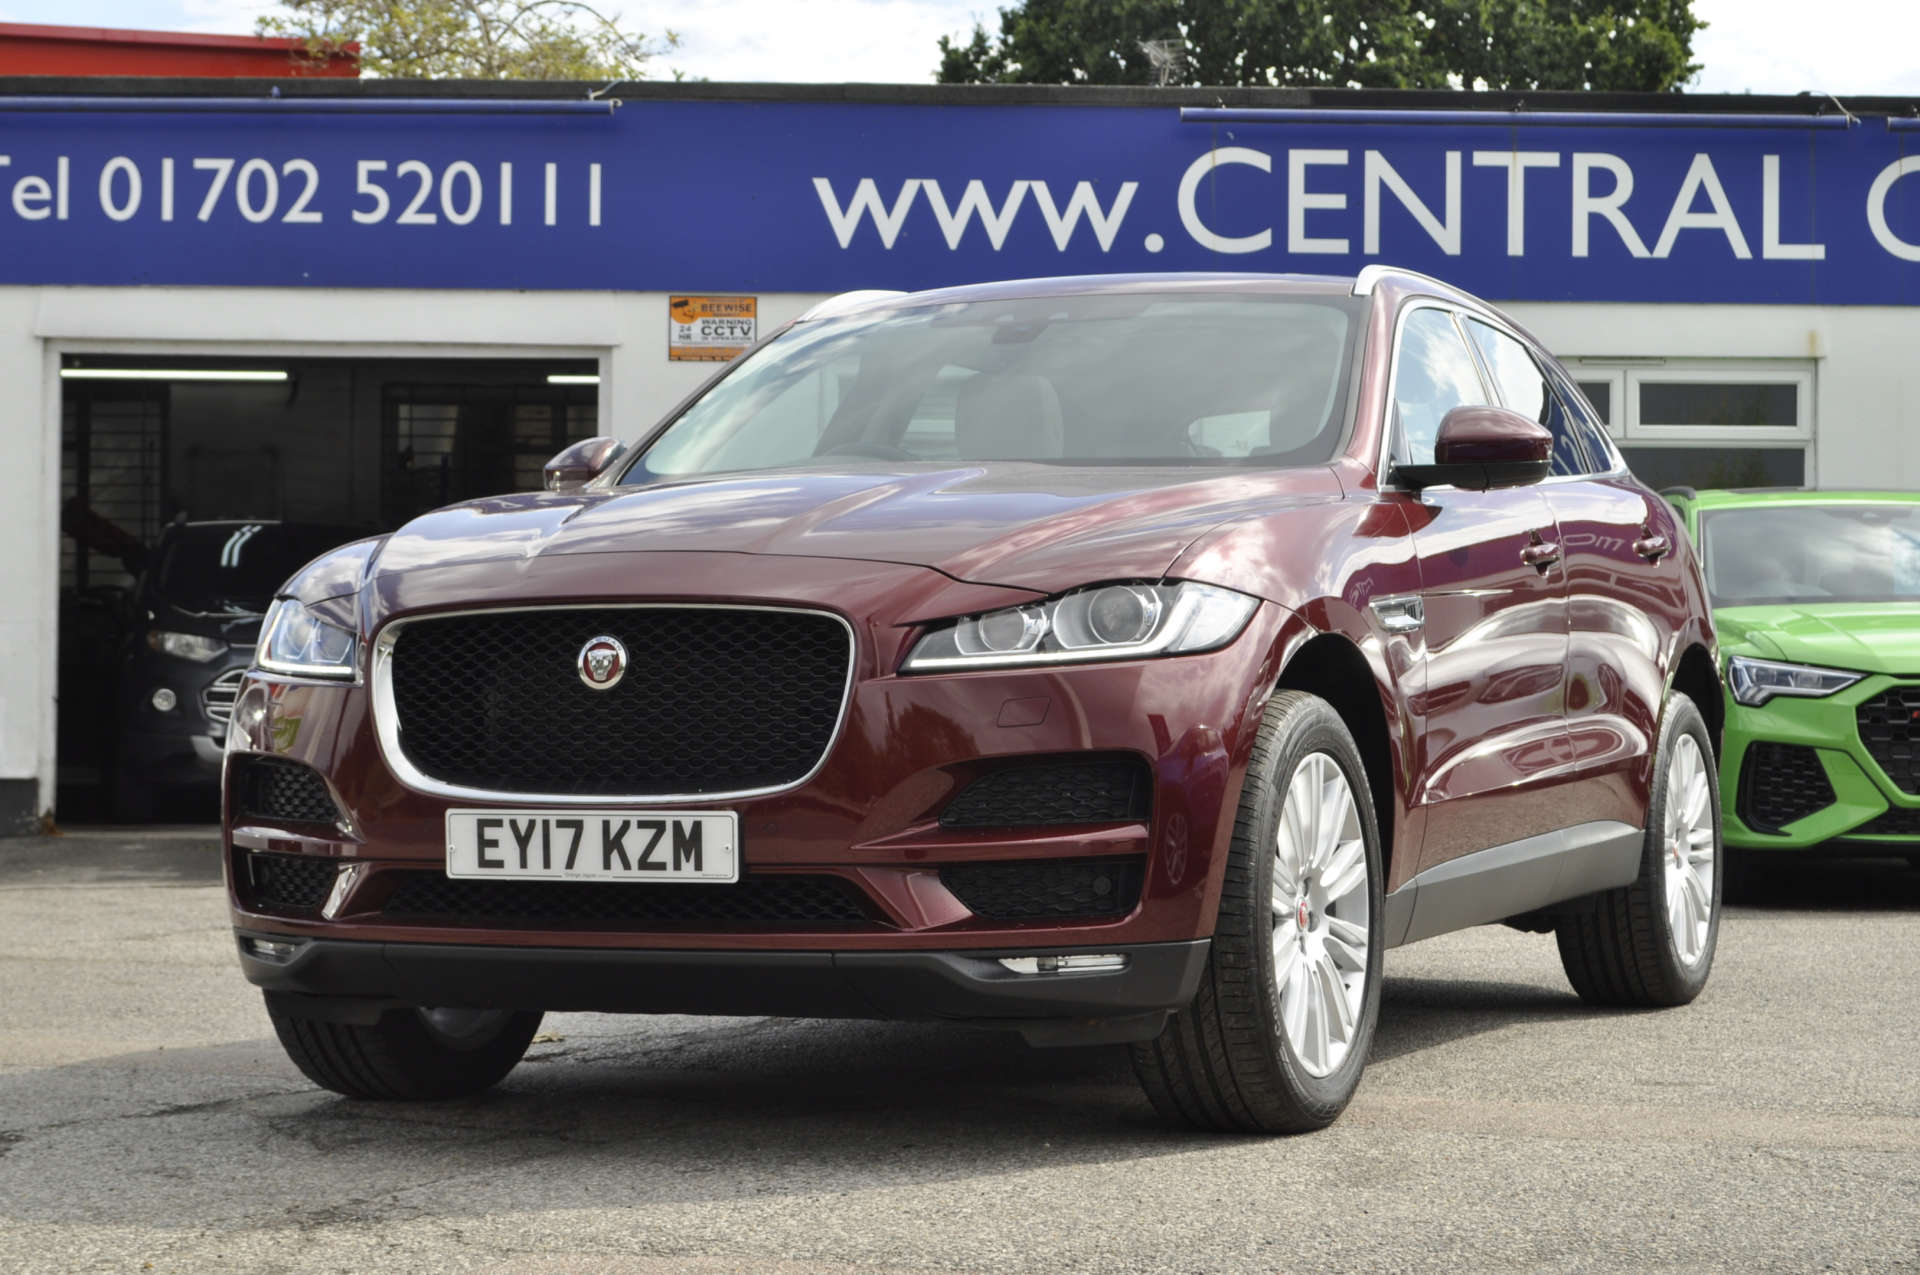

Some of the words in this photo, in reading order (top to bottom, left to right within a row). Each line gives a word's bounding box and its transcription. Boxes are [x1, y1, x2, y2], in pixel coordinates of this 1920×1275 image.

[99, 156, 323, 223] 01702
[352, 160, 602, 227] 520111
[812, 146, 1826, 260] www.CENTRAL
[701, 326, 752, 336] CCTV
[476, 818, 584, 870] EY17
[602, 819, 703, 872] KZM
